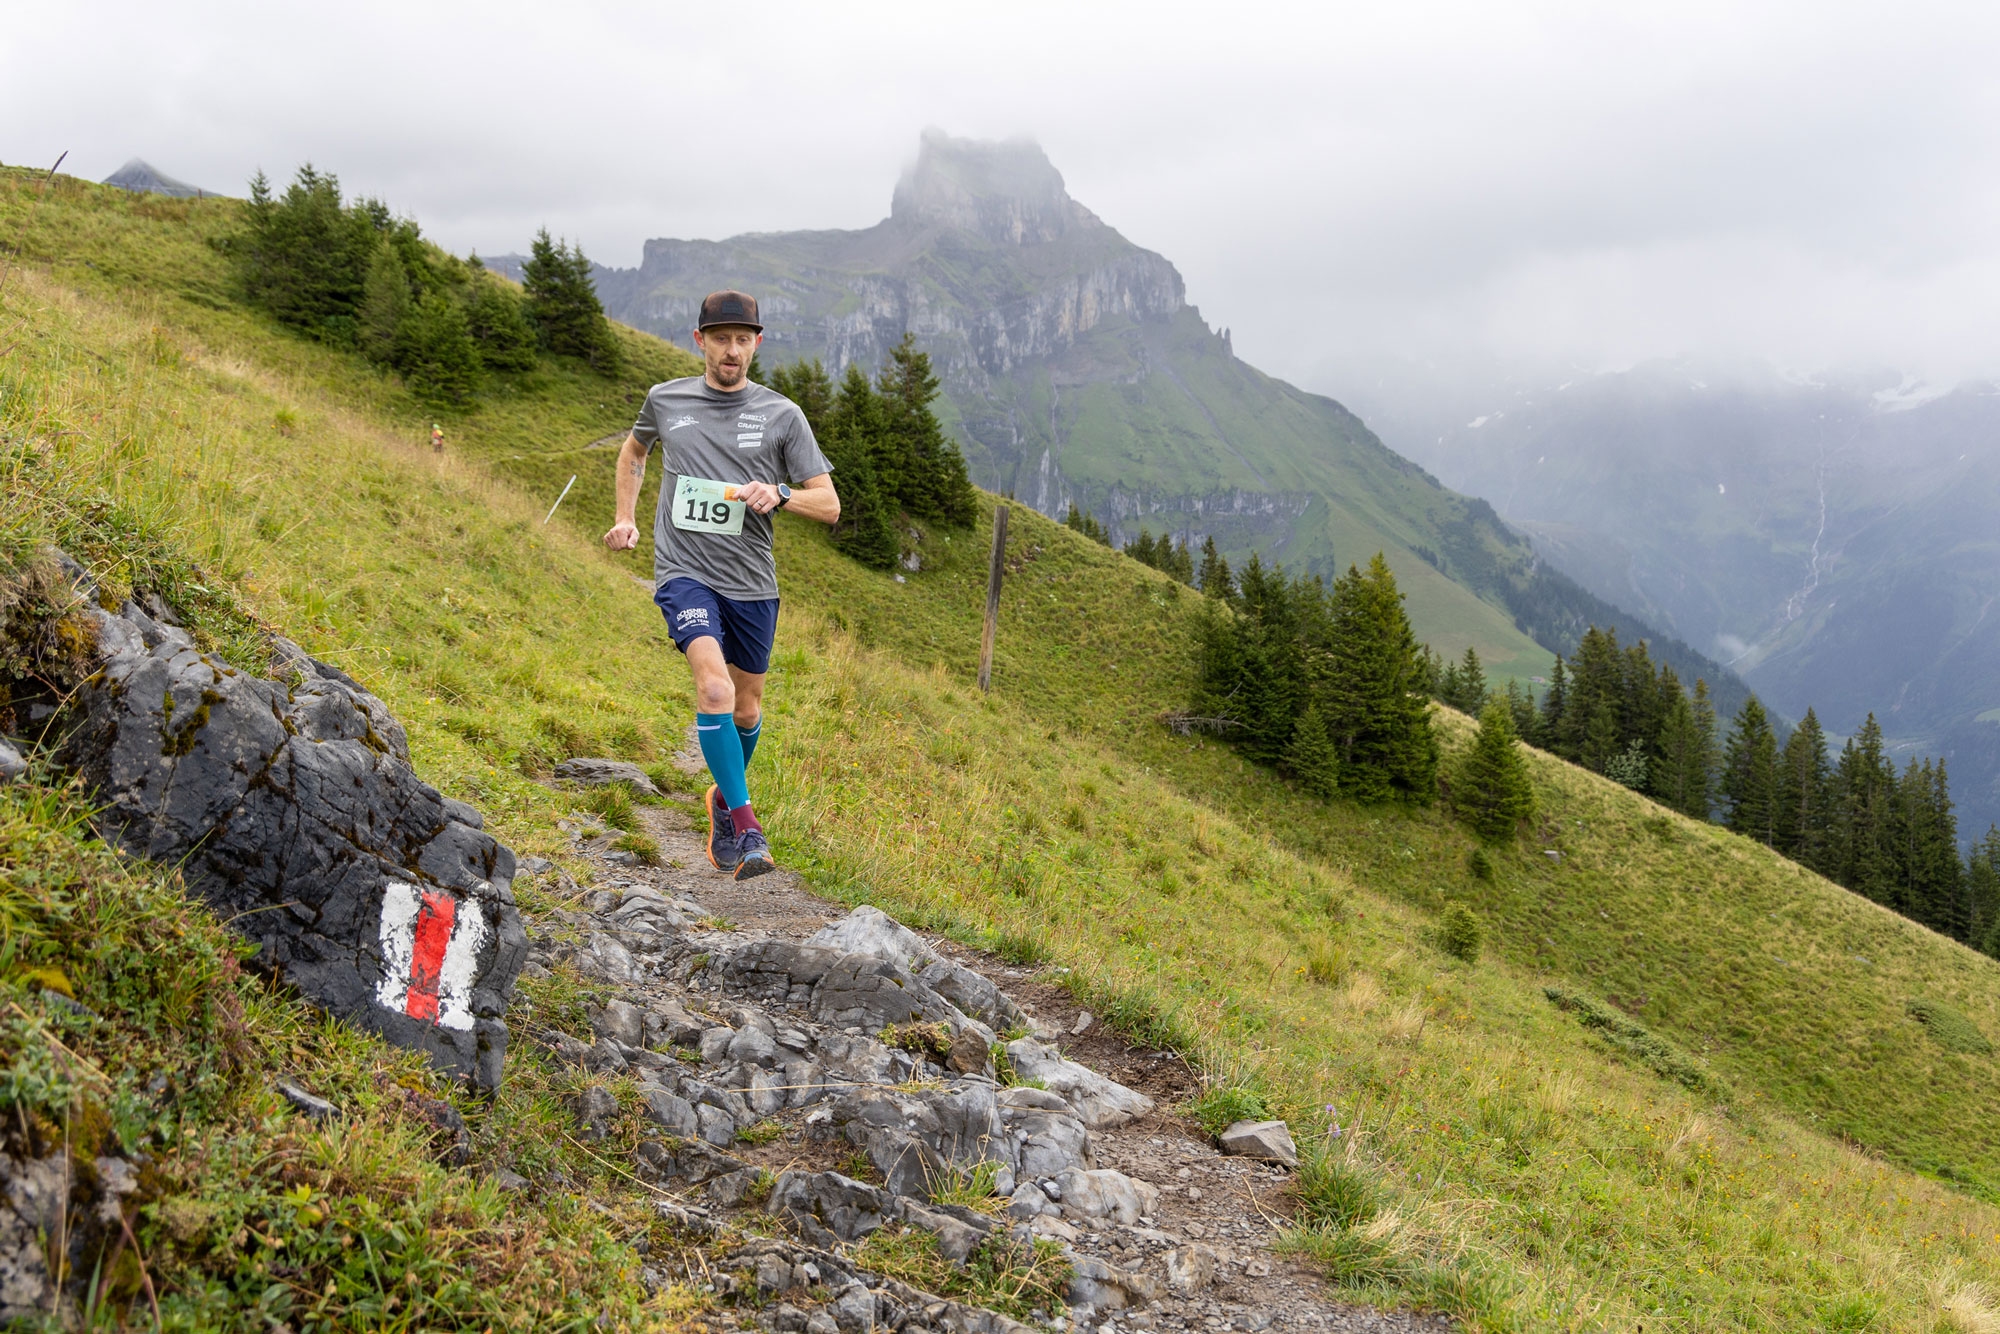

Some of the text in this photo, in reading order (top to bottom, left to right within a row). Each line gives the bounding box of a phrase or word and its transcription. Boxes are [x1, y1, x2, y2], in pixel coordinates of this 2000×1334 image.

[738, 422, 760, 430] CRAFT
[685, 499, 730, 524] 119
[677, 608, 708, 621] OCHSNER
[685, 613, 708, 621] SPORT
